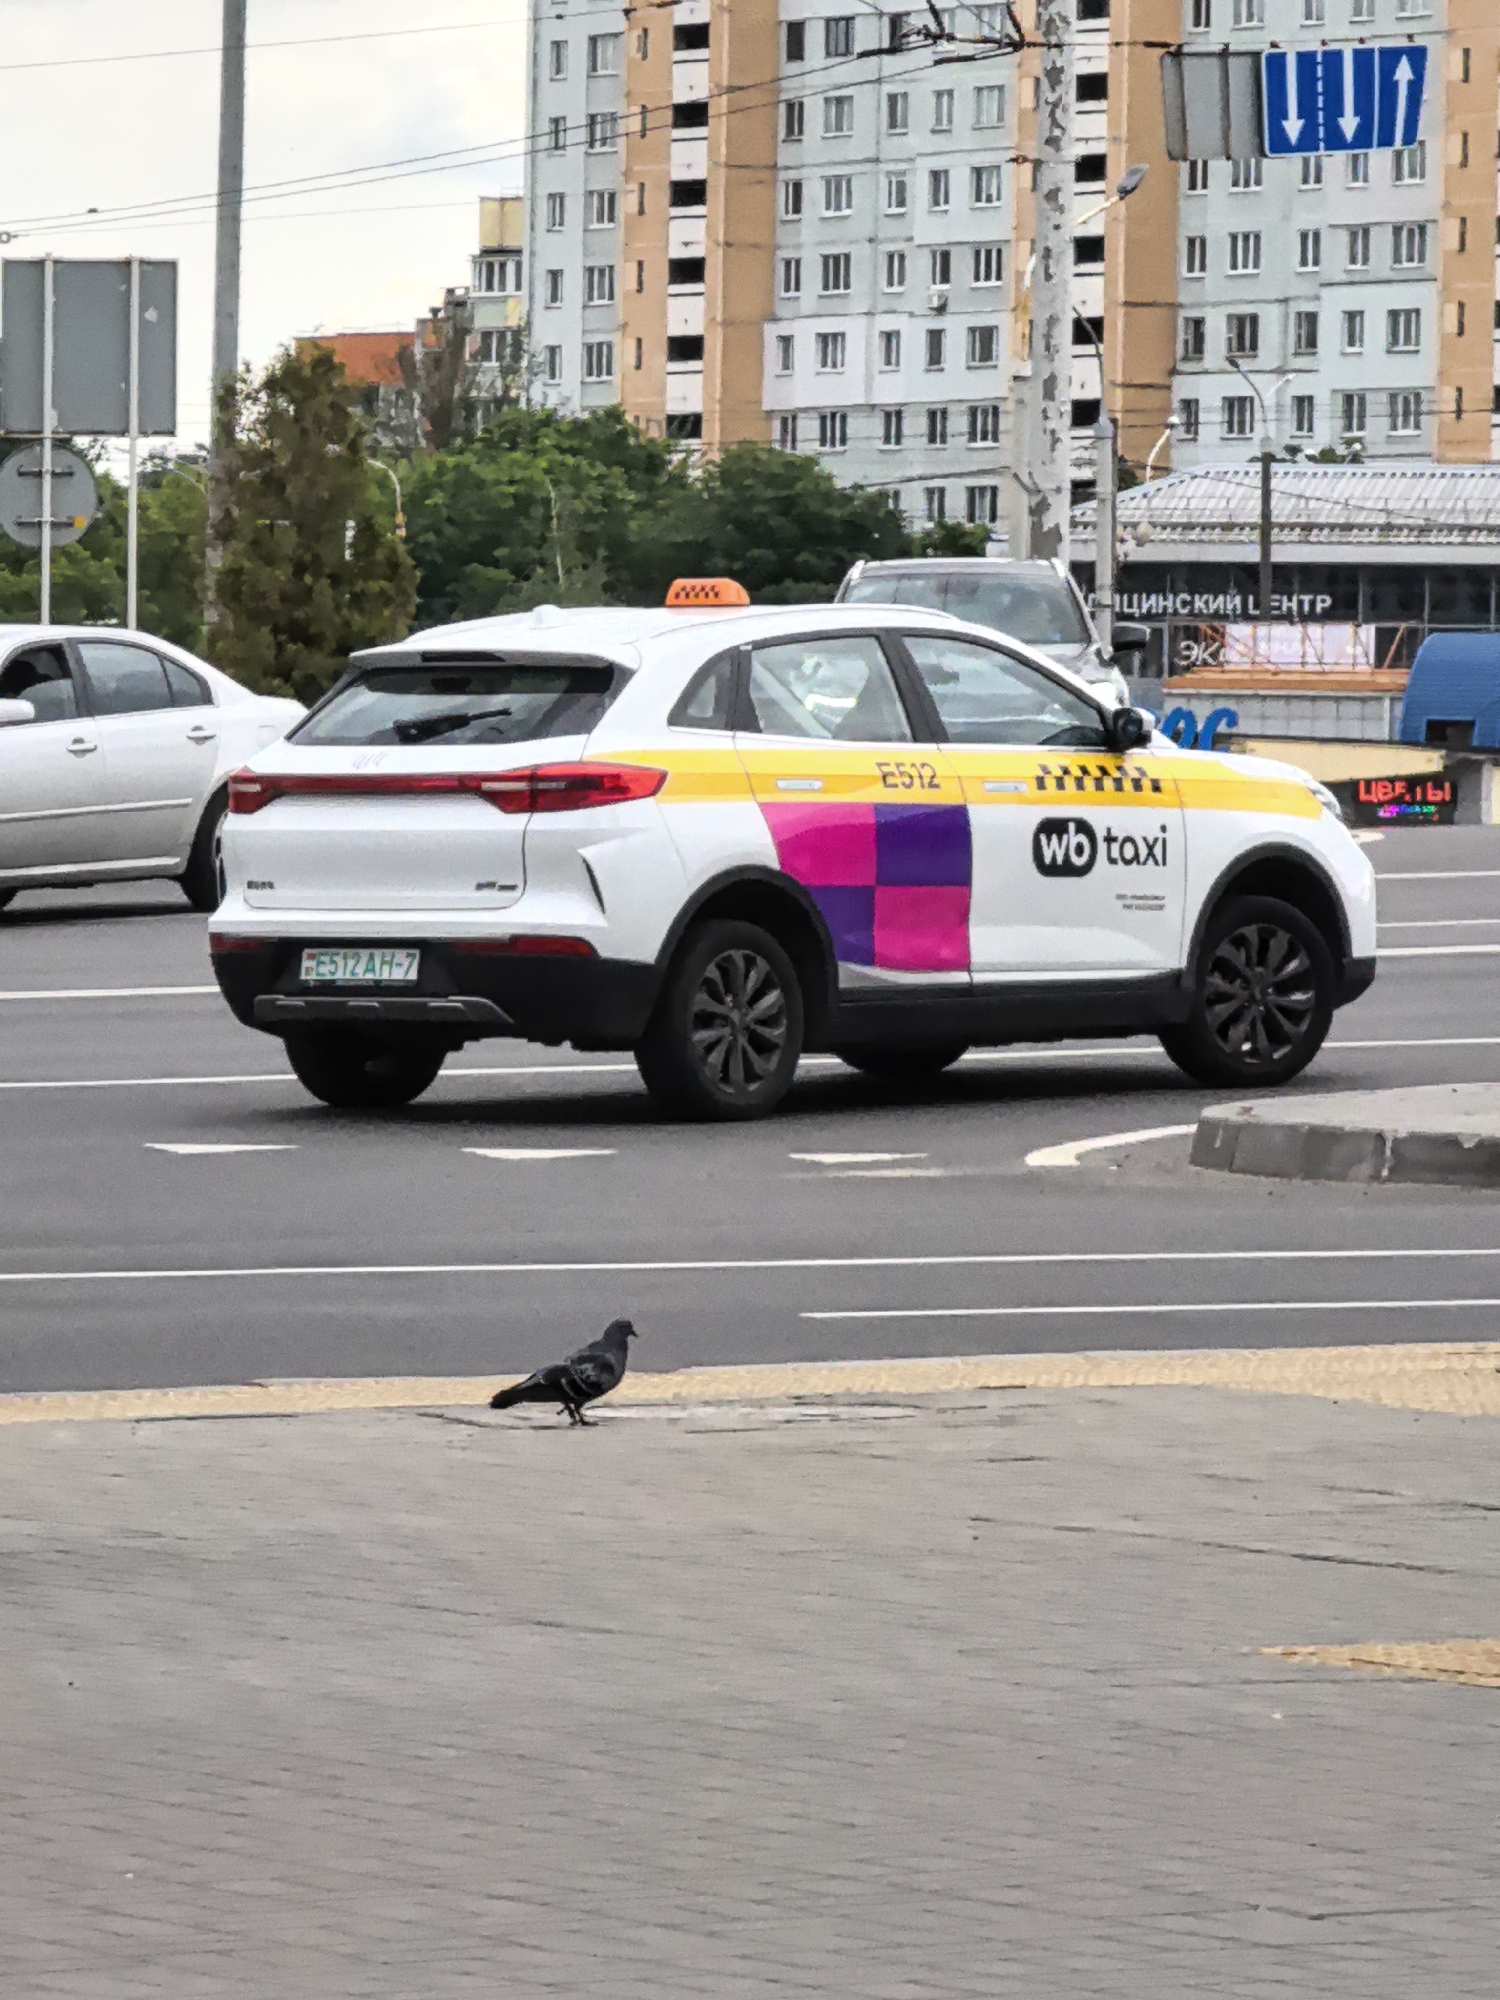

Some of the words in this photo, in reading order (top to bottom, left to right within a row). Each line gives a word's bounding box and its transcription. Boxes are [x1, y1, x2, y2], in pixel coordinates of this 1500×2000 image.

[875, 762, 941, 789] E512
[1040, 821, 1091, 866] wb
[1103, 824, 1167, 866] taxi
